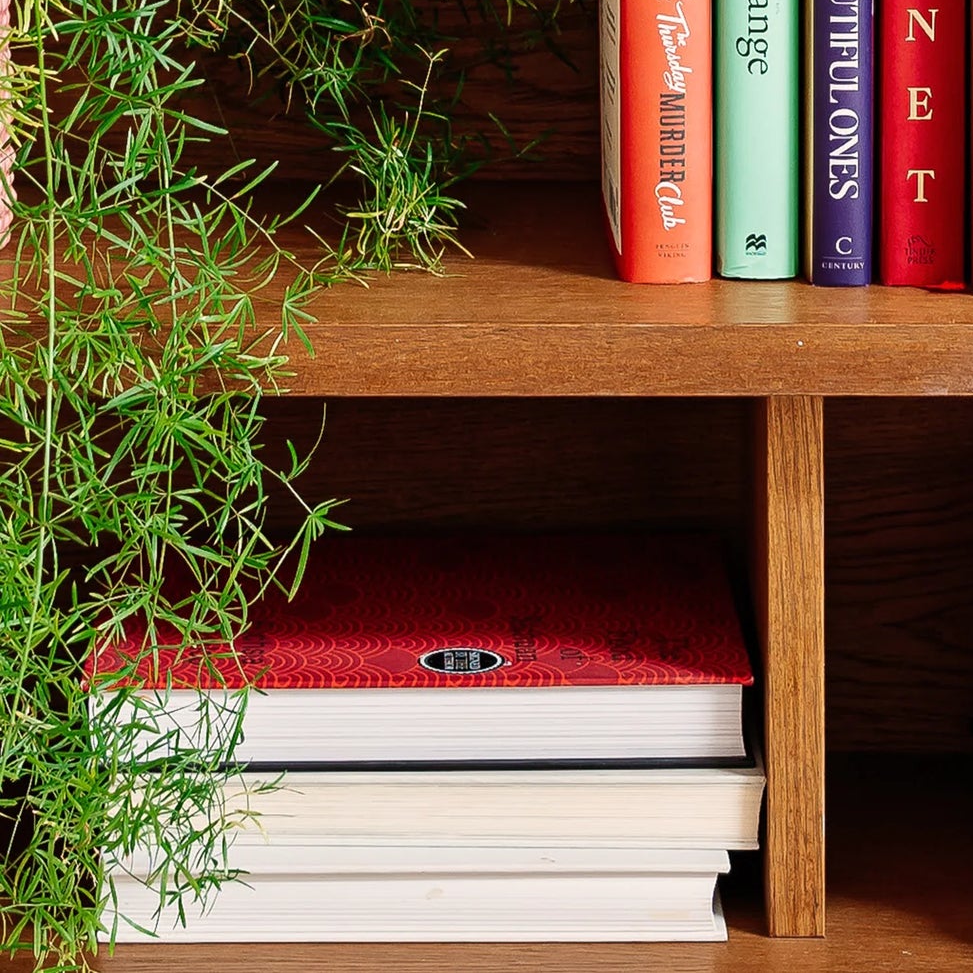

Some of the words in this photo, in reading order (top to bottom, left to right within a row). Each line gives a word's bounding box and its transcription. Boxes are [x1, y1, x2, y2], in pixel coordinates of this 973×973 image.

[656, 1, 693, 93] Thursday
[659, 92, 686, 183] MURDER
[828, 108, 860, 201] ONES
[655, 181, 687, 231] Club
[821, 261, 865, 270] CENTURY
